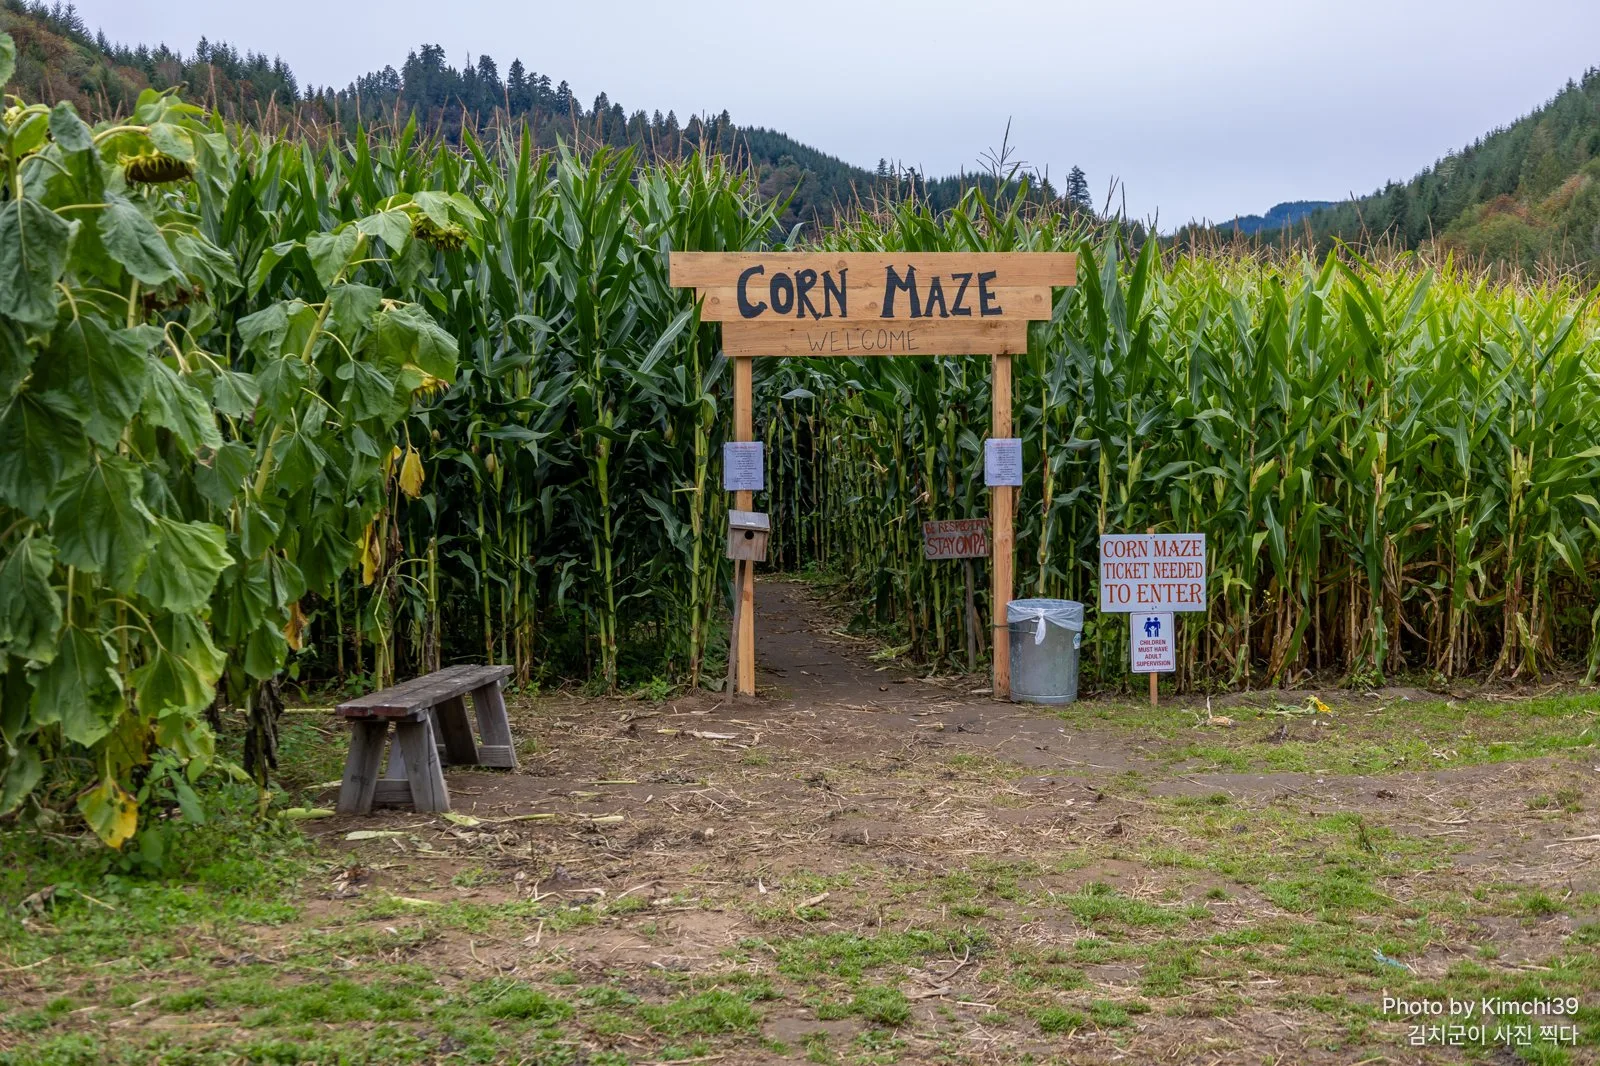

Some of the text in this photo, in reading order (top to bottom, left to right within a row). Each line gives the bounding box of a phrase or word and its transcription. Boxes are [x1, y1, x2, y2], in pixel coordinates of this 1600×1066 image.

[737, 264, 1003, 320] CORN MAZE
[807, 328, 919, 354] WELCOME
[925, 519, 989, 534] BE RESPECTFU
[927, 532, 989, 556] STAY ON PA
[1103, 540, 1203, 559] CORN MAZE
[1103, 562, 1203, 579] TICKET NEEDED
[1104, 583, 1202, 604] TO ENTER
